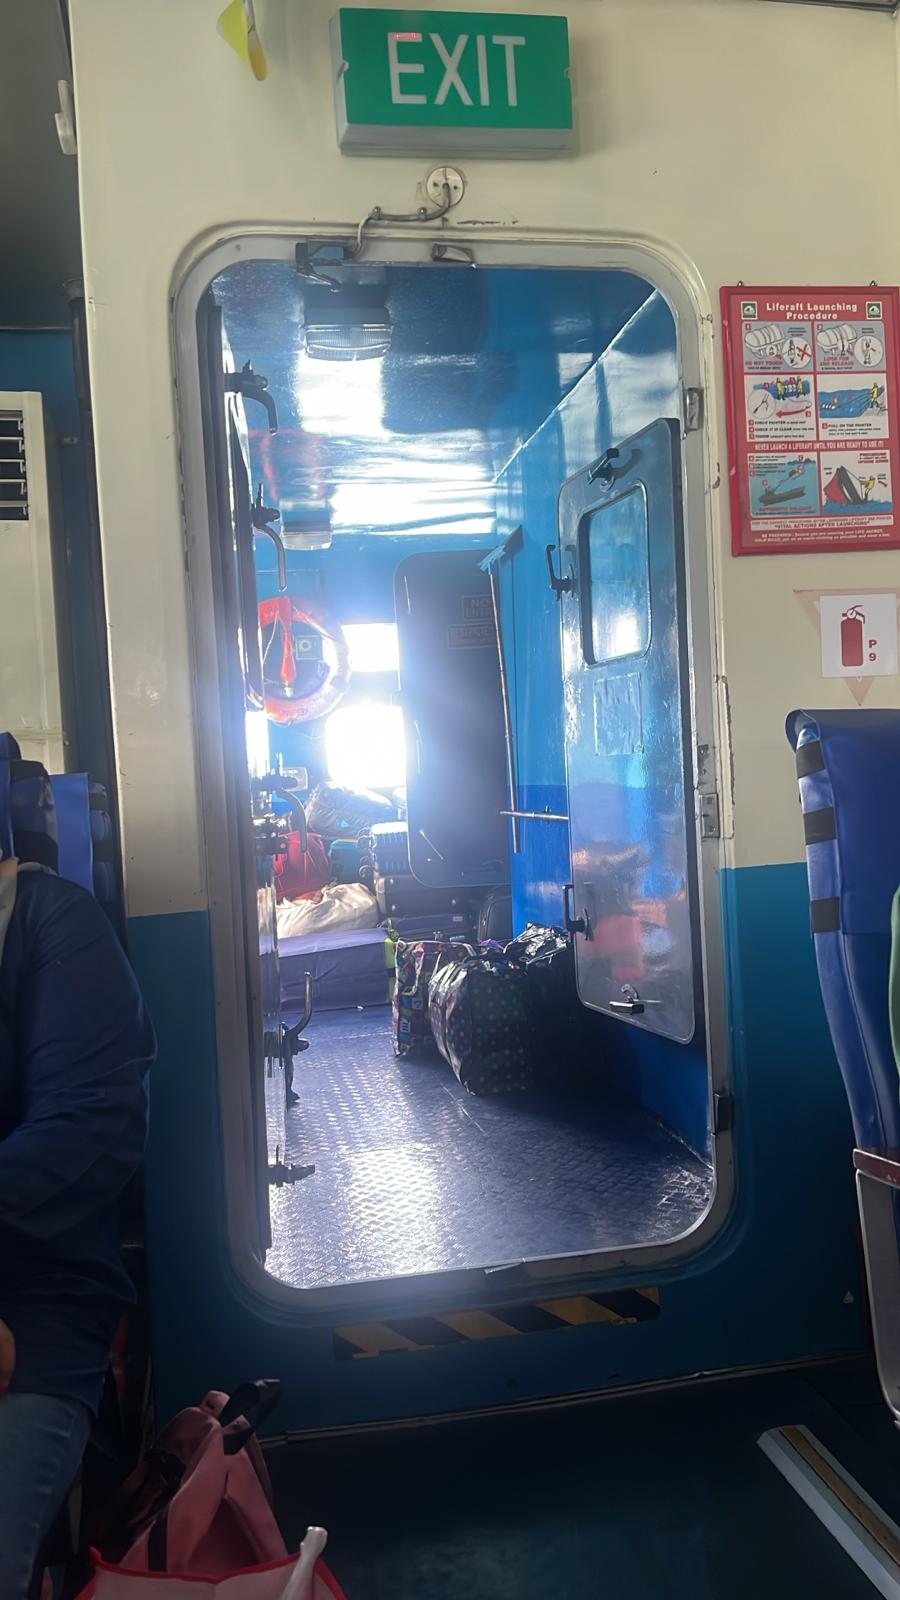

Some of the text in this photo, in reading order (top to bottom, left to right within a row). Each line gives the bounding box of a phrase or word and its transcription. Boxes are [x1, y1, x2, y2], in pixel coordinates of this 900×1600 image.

[387, 32, 526, 107] EXIT
[766, 302, 857, 312] Liferaft Launching
[786, 312, 838, 320] Procedure
[472, 598, 490, 608] NO
[868, 640, 878, 648] P
[868, 652, 876, 662] 9
